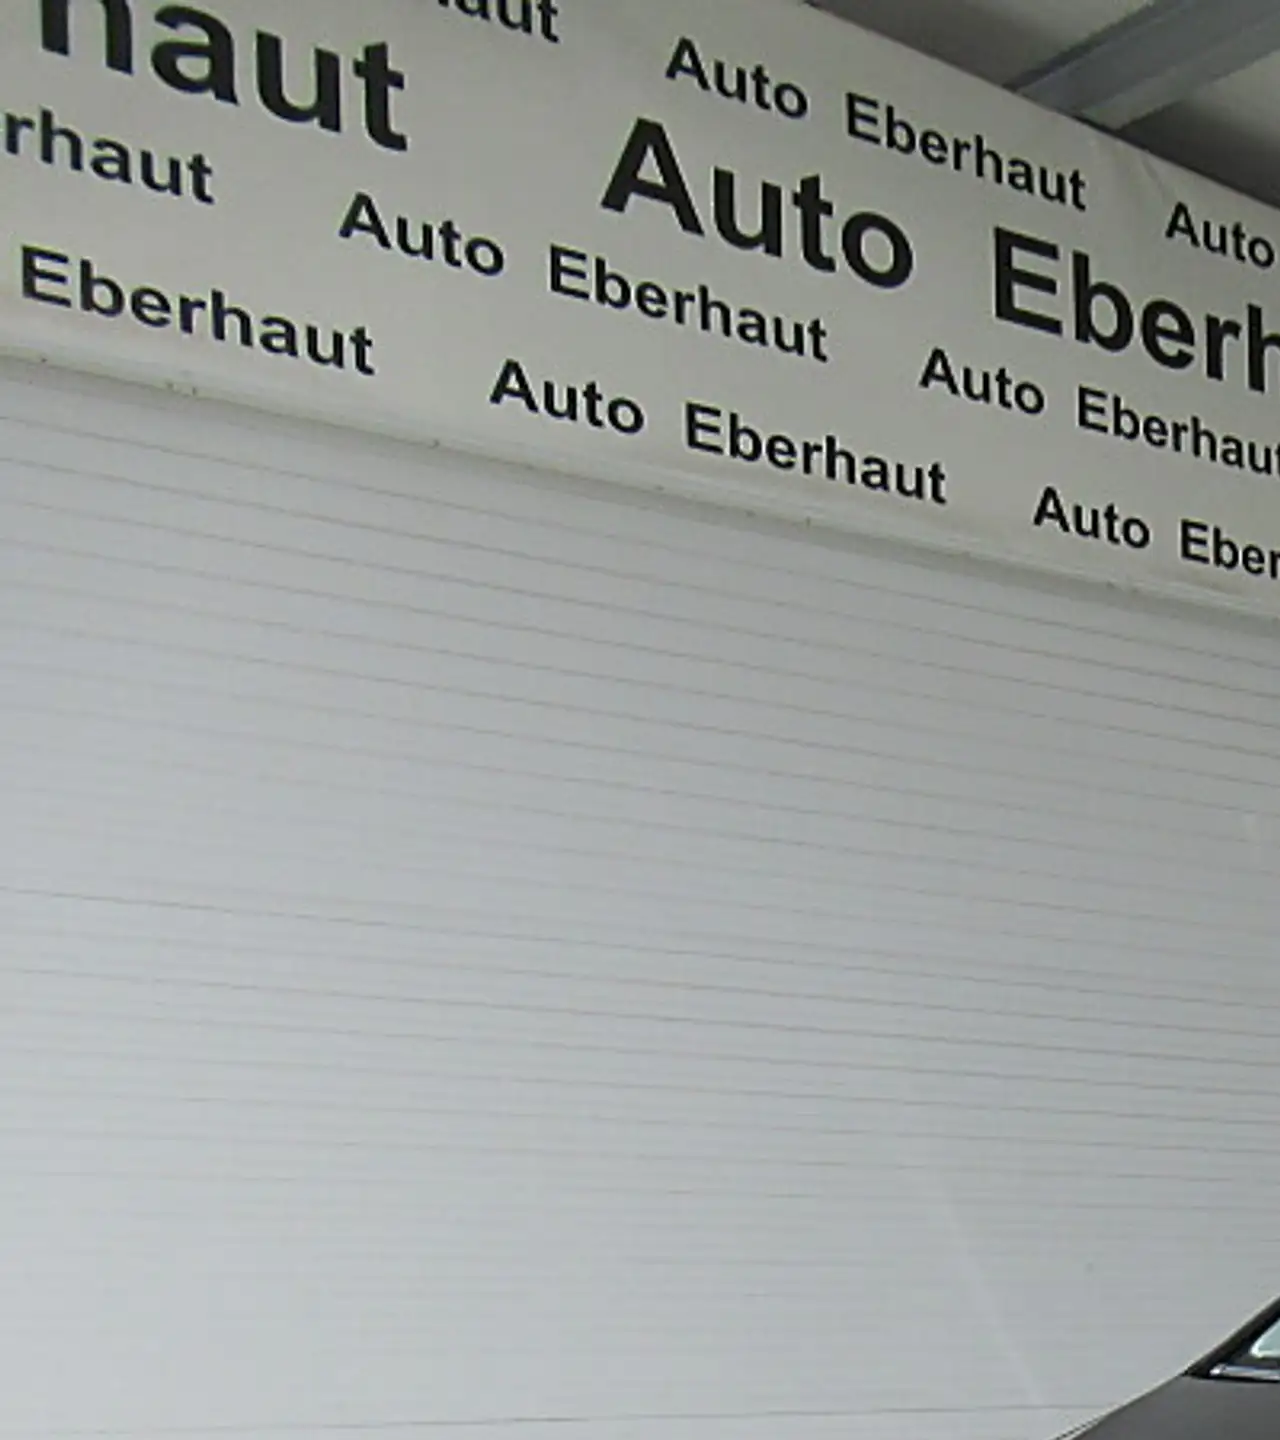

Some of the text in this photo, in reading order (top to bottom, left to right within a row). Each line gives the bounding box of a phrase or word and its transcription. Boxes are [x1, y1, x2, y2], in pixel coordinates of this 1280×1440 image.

[665, 36, 1087, 213] Auto Eberhaut
[601, 117, 914, 289] Auto
[1164, 201, 1275, 270] Auto
[21, 245, 375, 376] Eberhaut
[338, 191, 828, 364] Auto Eberhaut
[489, 358, 947, 506] Auto Eberhaut
[918, 347, 1045, 415] Auto
[1033, 486, 1150, 550] Auto
